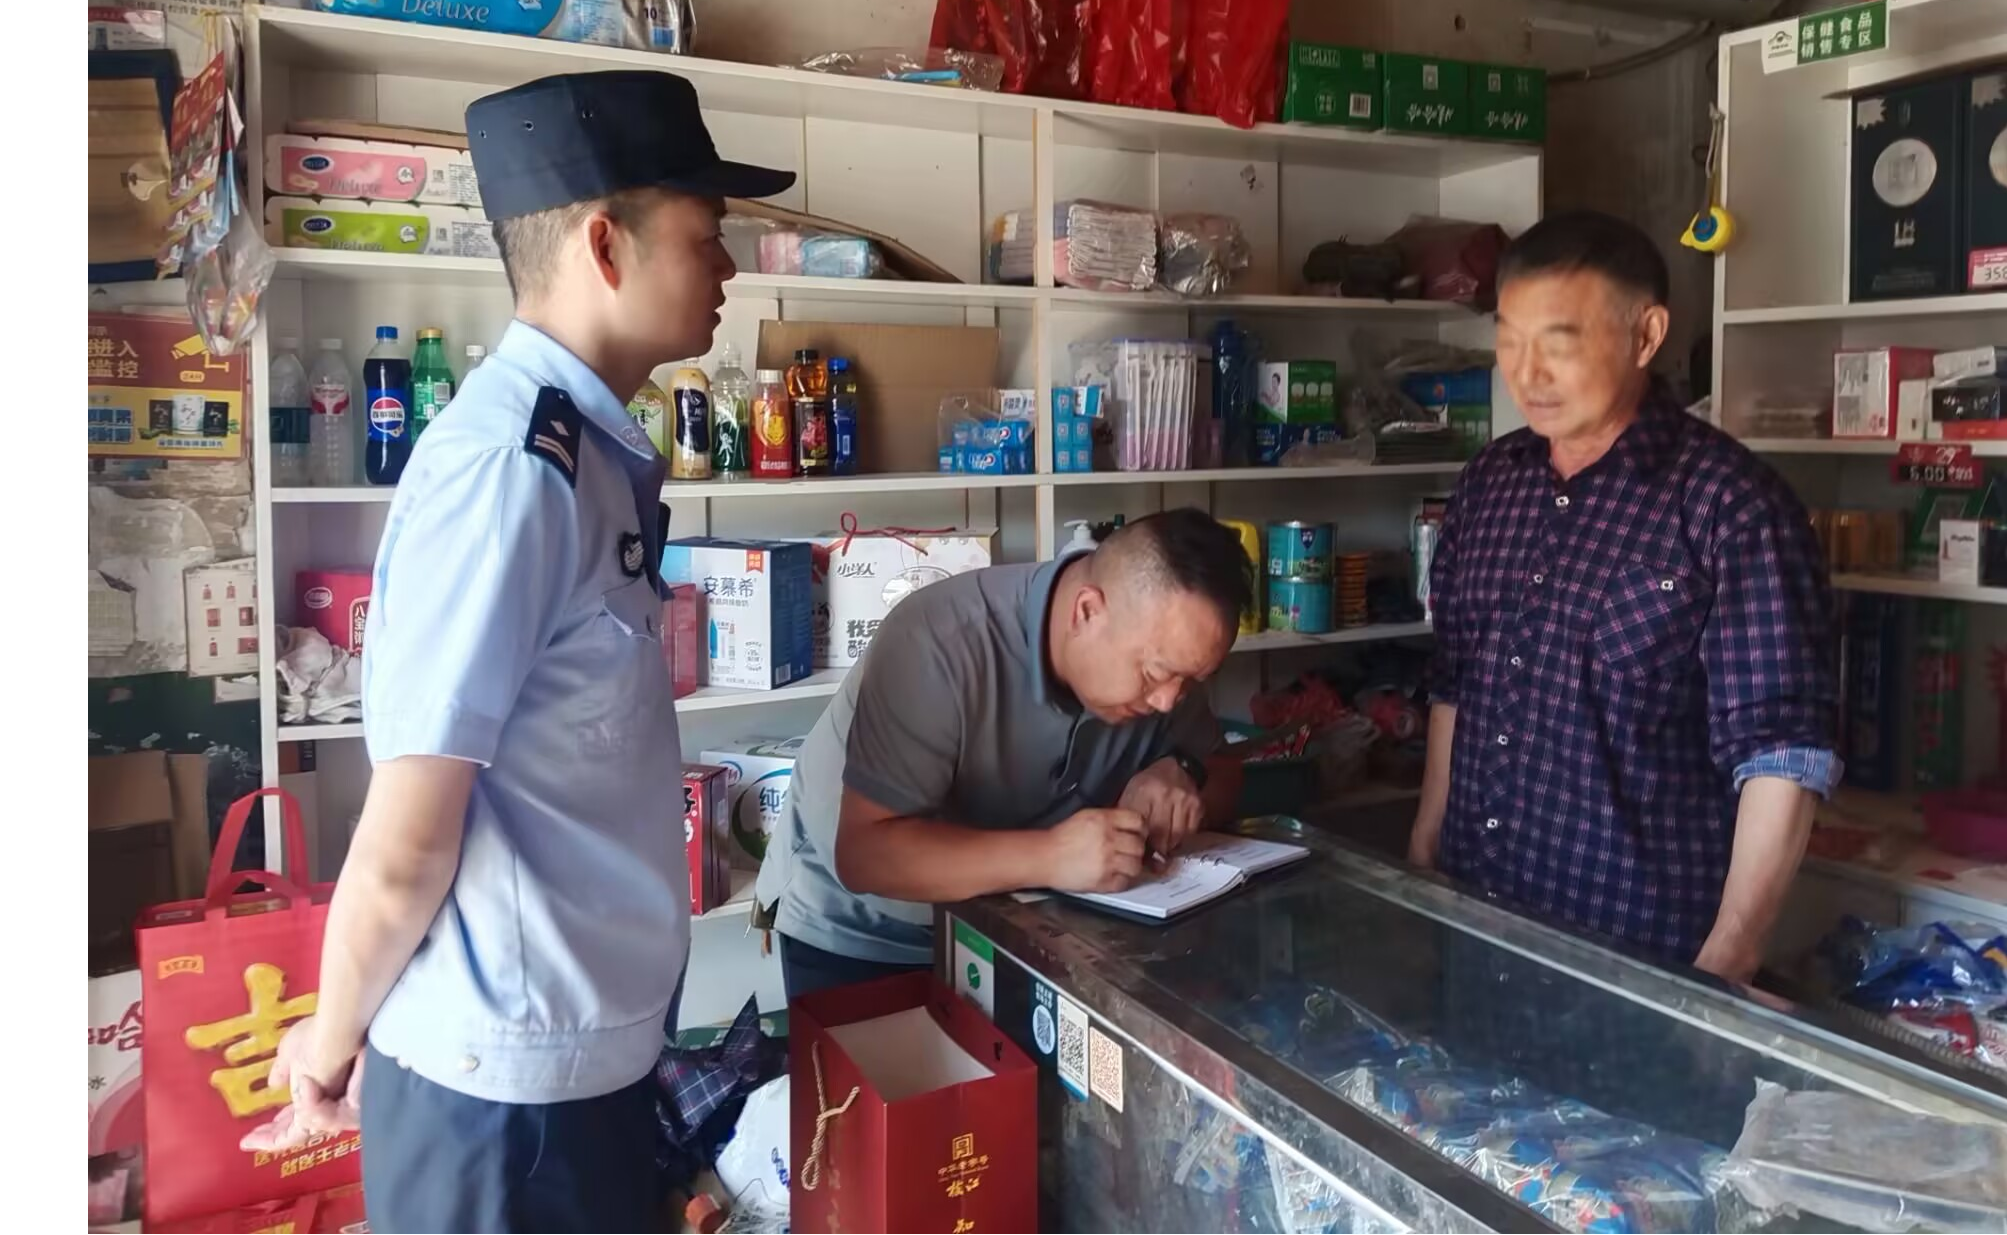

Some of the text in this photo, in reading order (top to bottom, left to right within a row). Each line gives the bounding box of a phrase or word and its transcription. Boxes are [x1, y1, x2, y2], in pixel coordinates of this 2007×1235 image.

[402, 0, 490, 23] Deluxe
[1802, 9, 1872, 41] 保健食品
[1801, 30, 1872, 58] 销售专区
[88, 338, 139, 358] 进入
[88, 359, 139, 379] 监控
[837, 562, 876, 578] 小洋人
[703, 576, 753, 598] 安慕希
[759, 786, 786, 814] 纯
